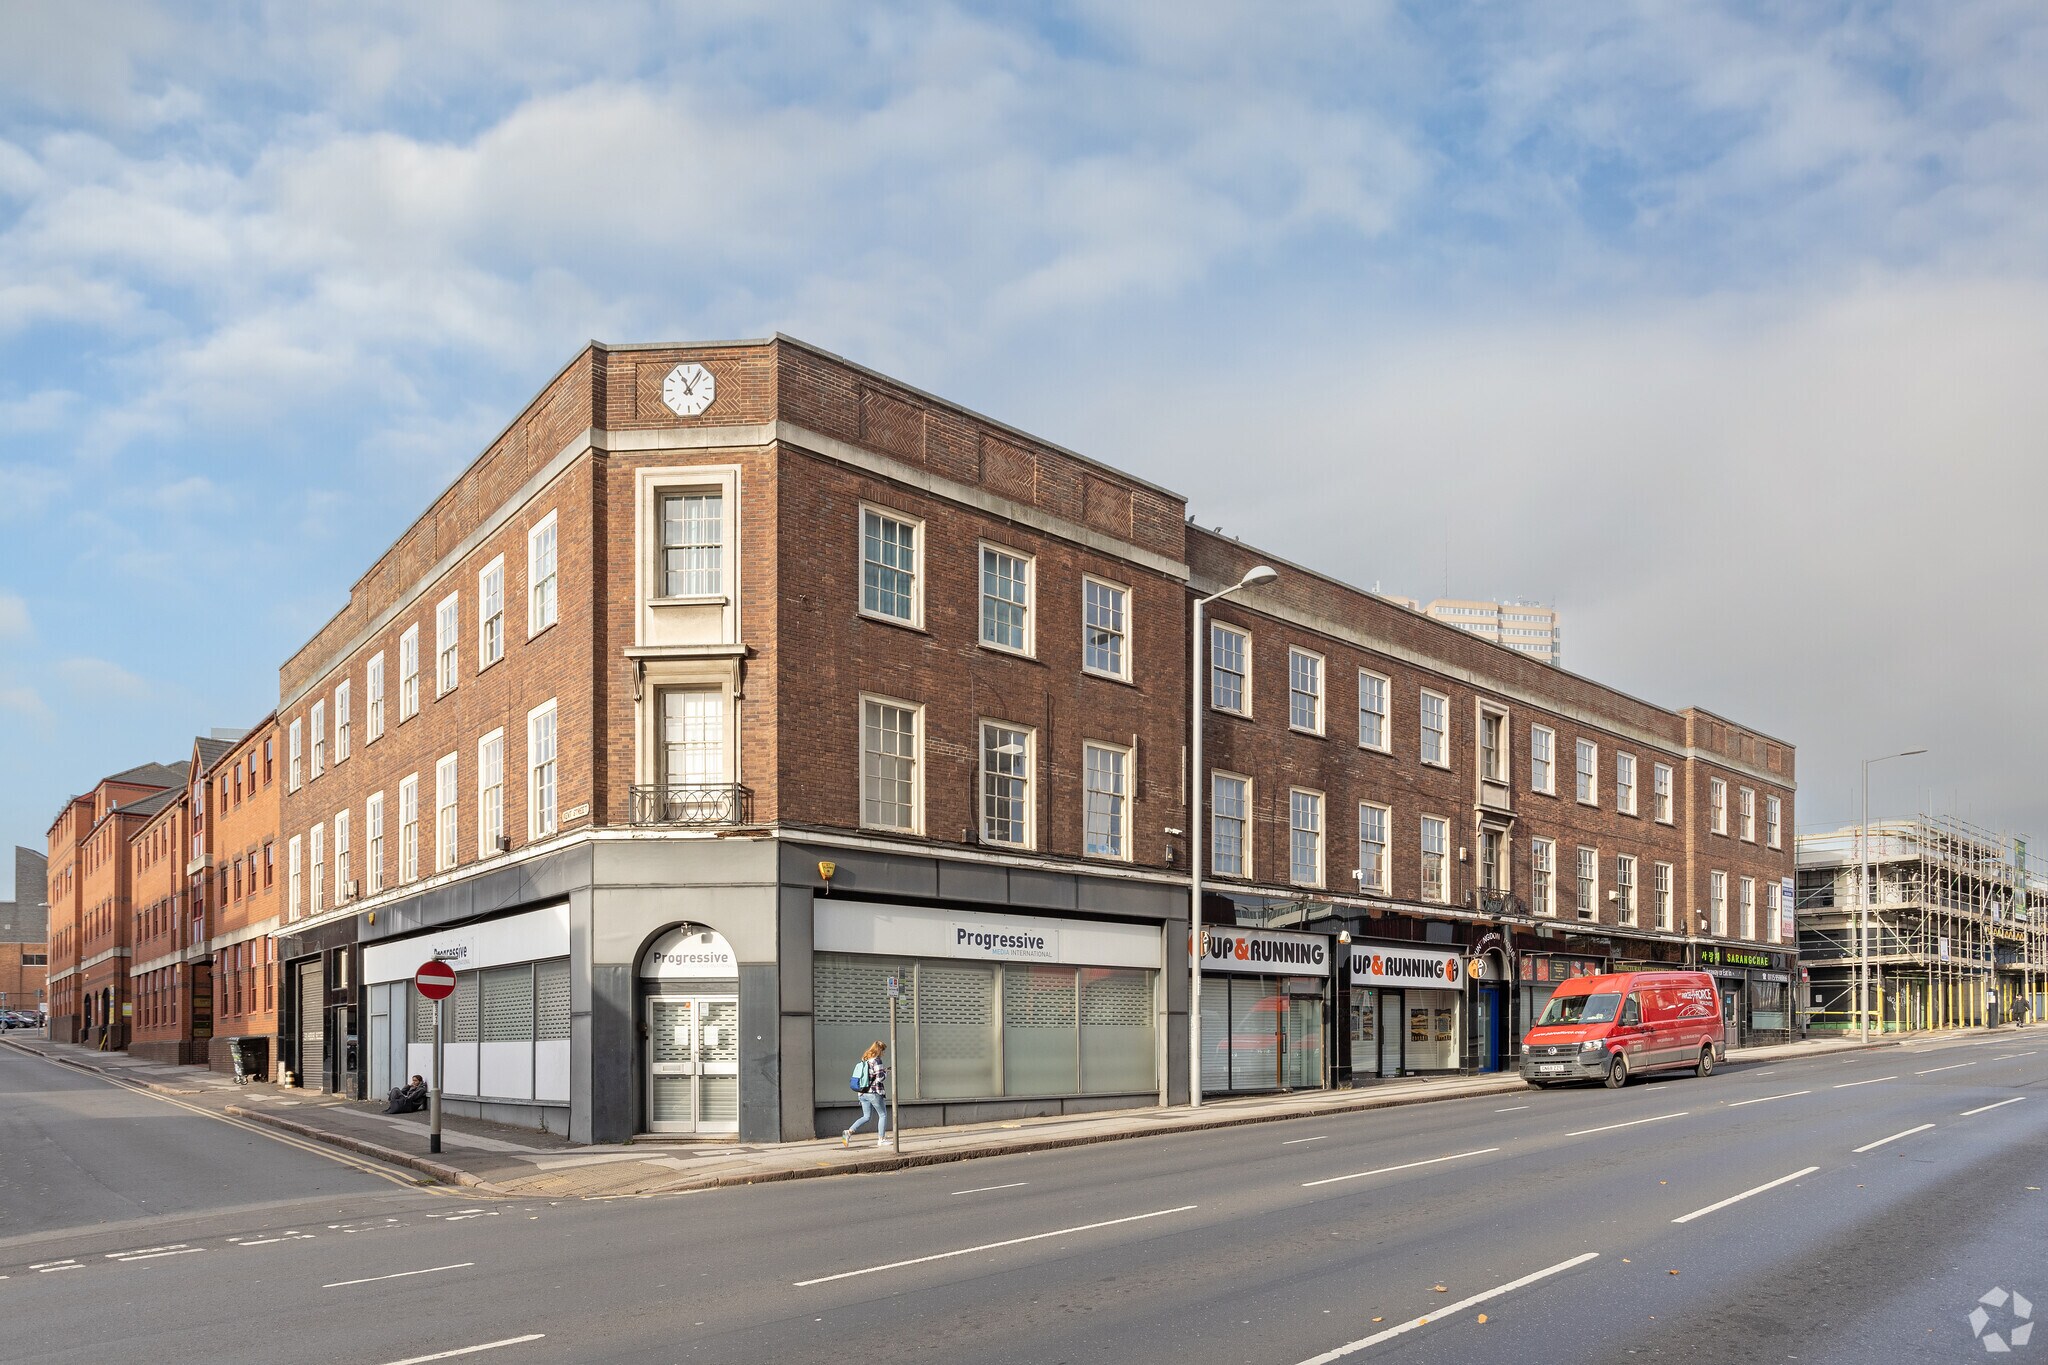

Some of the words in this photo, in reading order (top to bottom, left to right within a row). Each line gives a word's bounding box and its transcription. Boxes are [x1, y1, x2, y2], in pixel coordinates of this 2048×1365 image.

[573, 804, 588, 817] STREET
[957, 928, 1044, 950] Progressive
[653, 952, 728, 965] Progressive
[1011, 949, 1052, 958] INTERNATIONAL
[1726, 953, 1769, 966] SARANGCHAE
